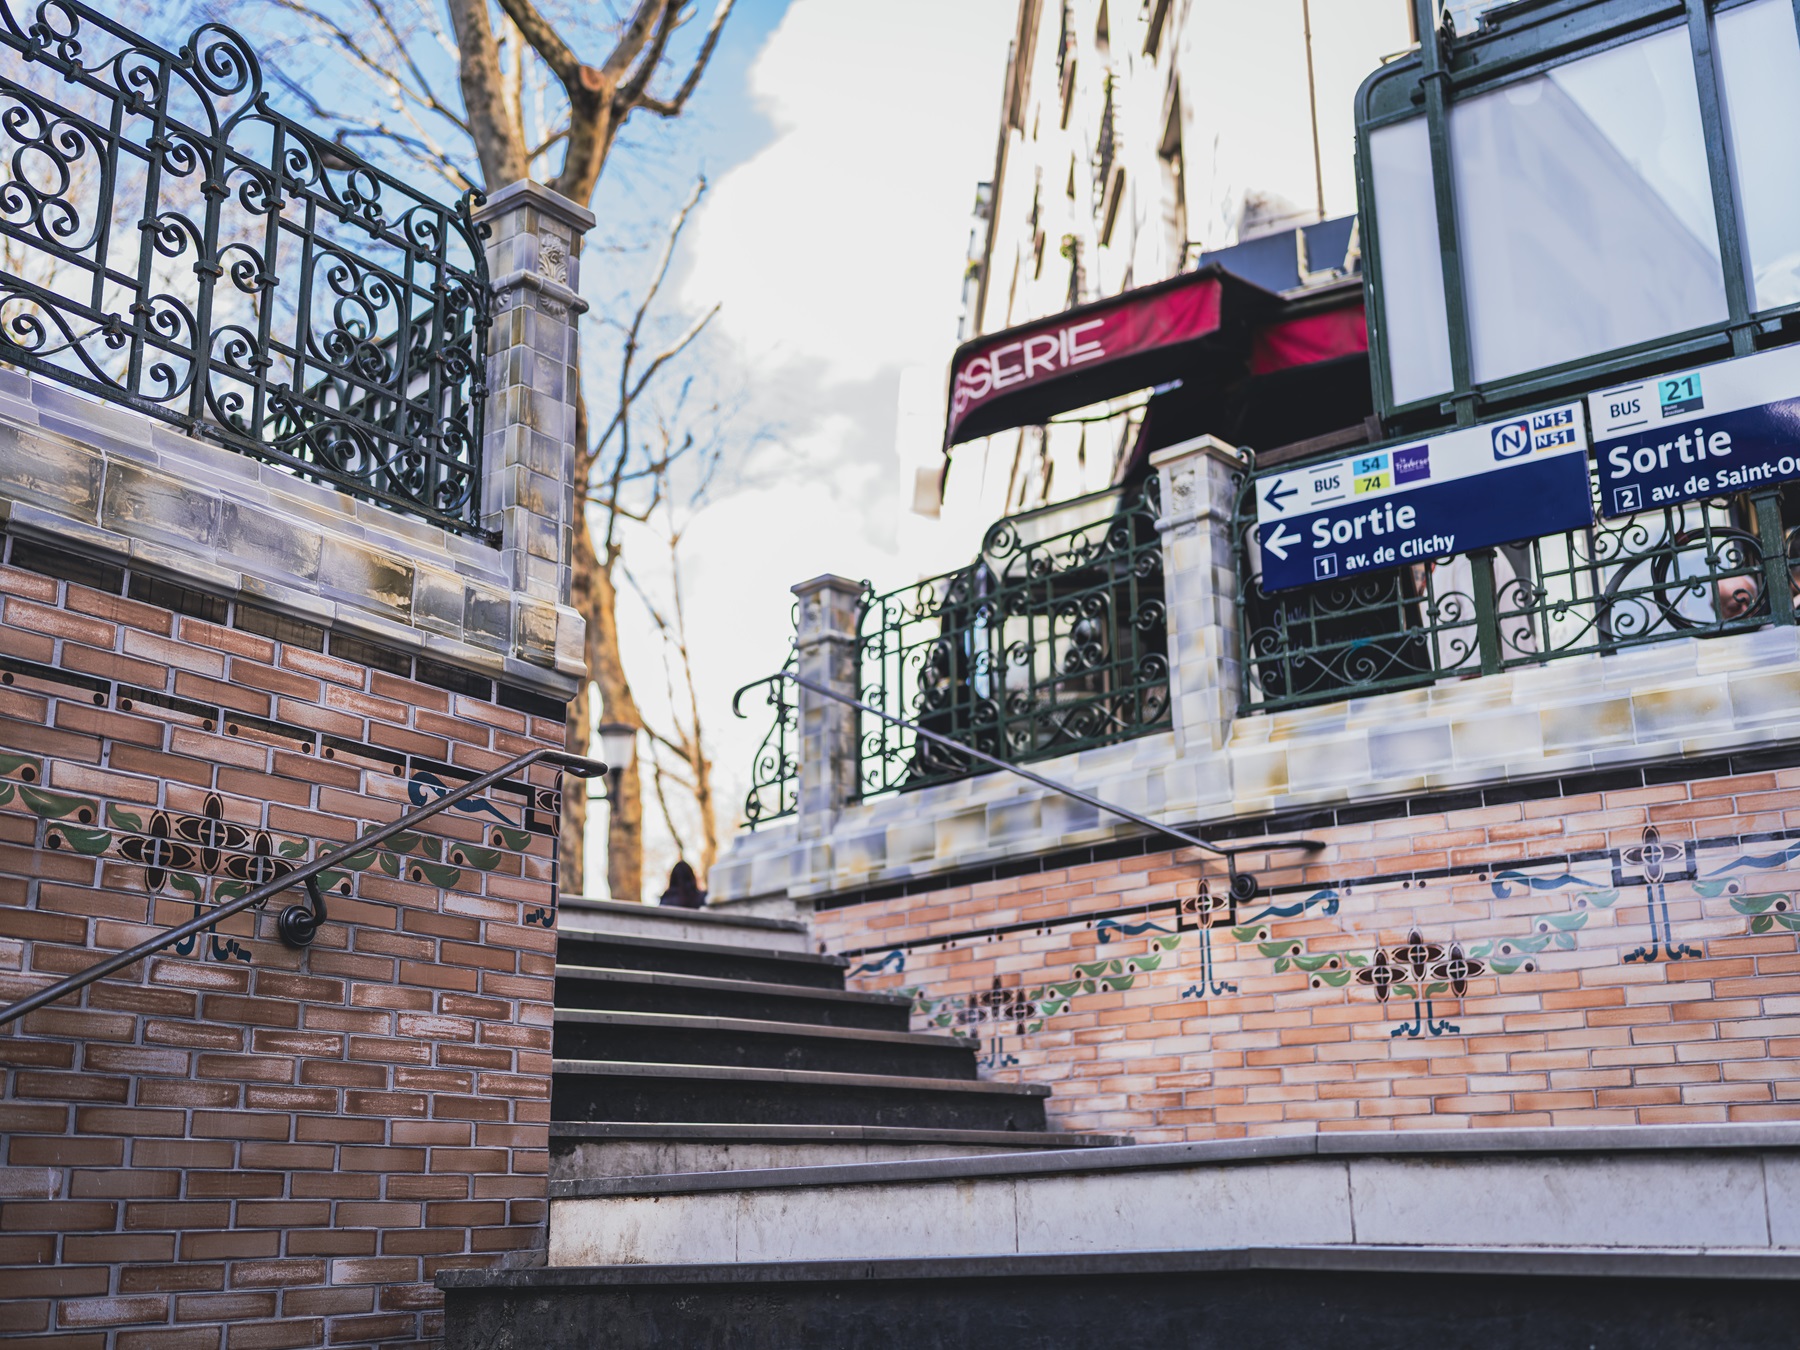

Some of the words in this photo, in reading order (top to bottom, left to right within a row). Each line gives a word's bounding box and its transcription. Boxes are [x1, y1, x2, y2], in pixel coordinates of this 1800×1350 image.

[1665, 377, 1694, 401] 21
[1610, 399, 1641, 418] BUS
[1534, 411, 1567, 428] N15
[1501, 430, 1521, 452] N
[1537, 431, 1568, 447] N51
[1608, 427, 1732, 479] Sortie
[1362, 458, 1381, 473] 54
[1314, 475, 1341, 493] BUS
[1363, 477, 1382, 491] 74
[1621, 490, 1635, 508] 2
[1652, 484, 1680, 501] av.
[1684, 476, 1710, 494] de
[1311, 502, 1416, 549] Sortie
[1346, 553, 1370, 570] av.
[1373, 546, 1395, 564] de
[1400, 534, 1455, 558] Clichy
